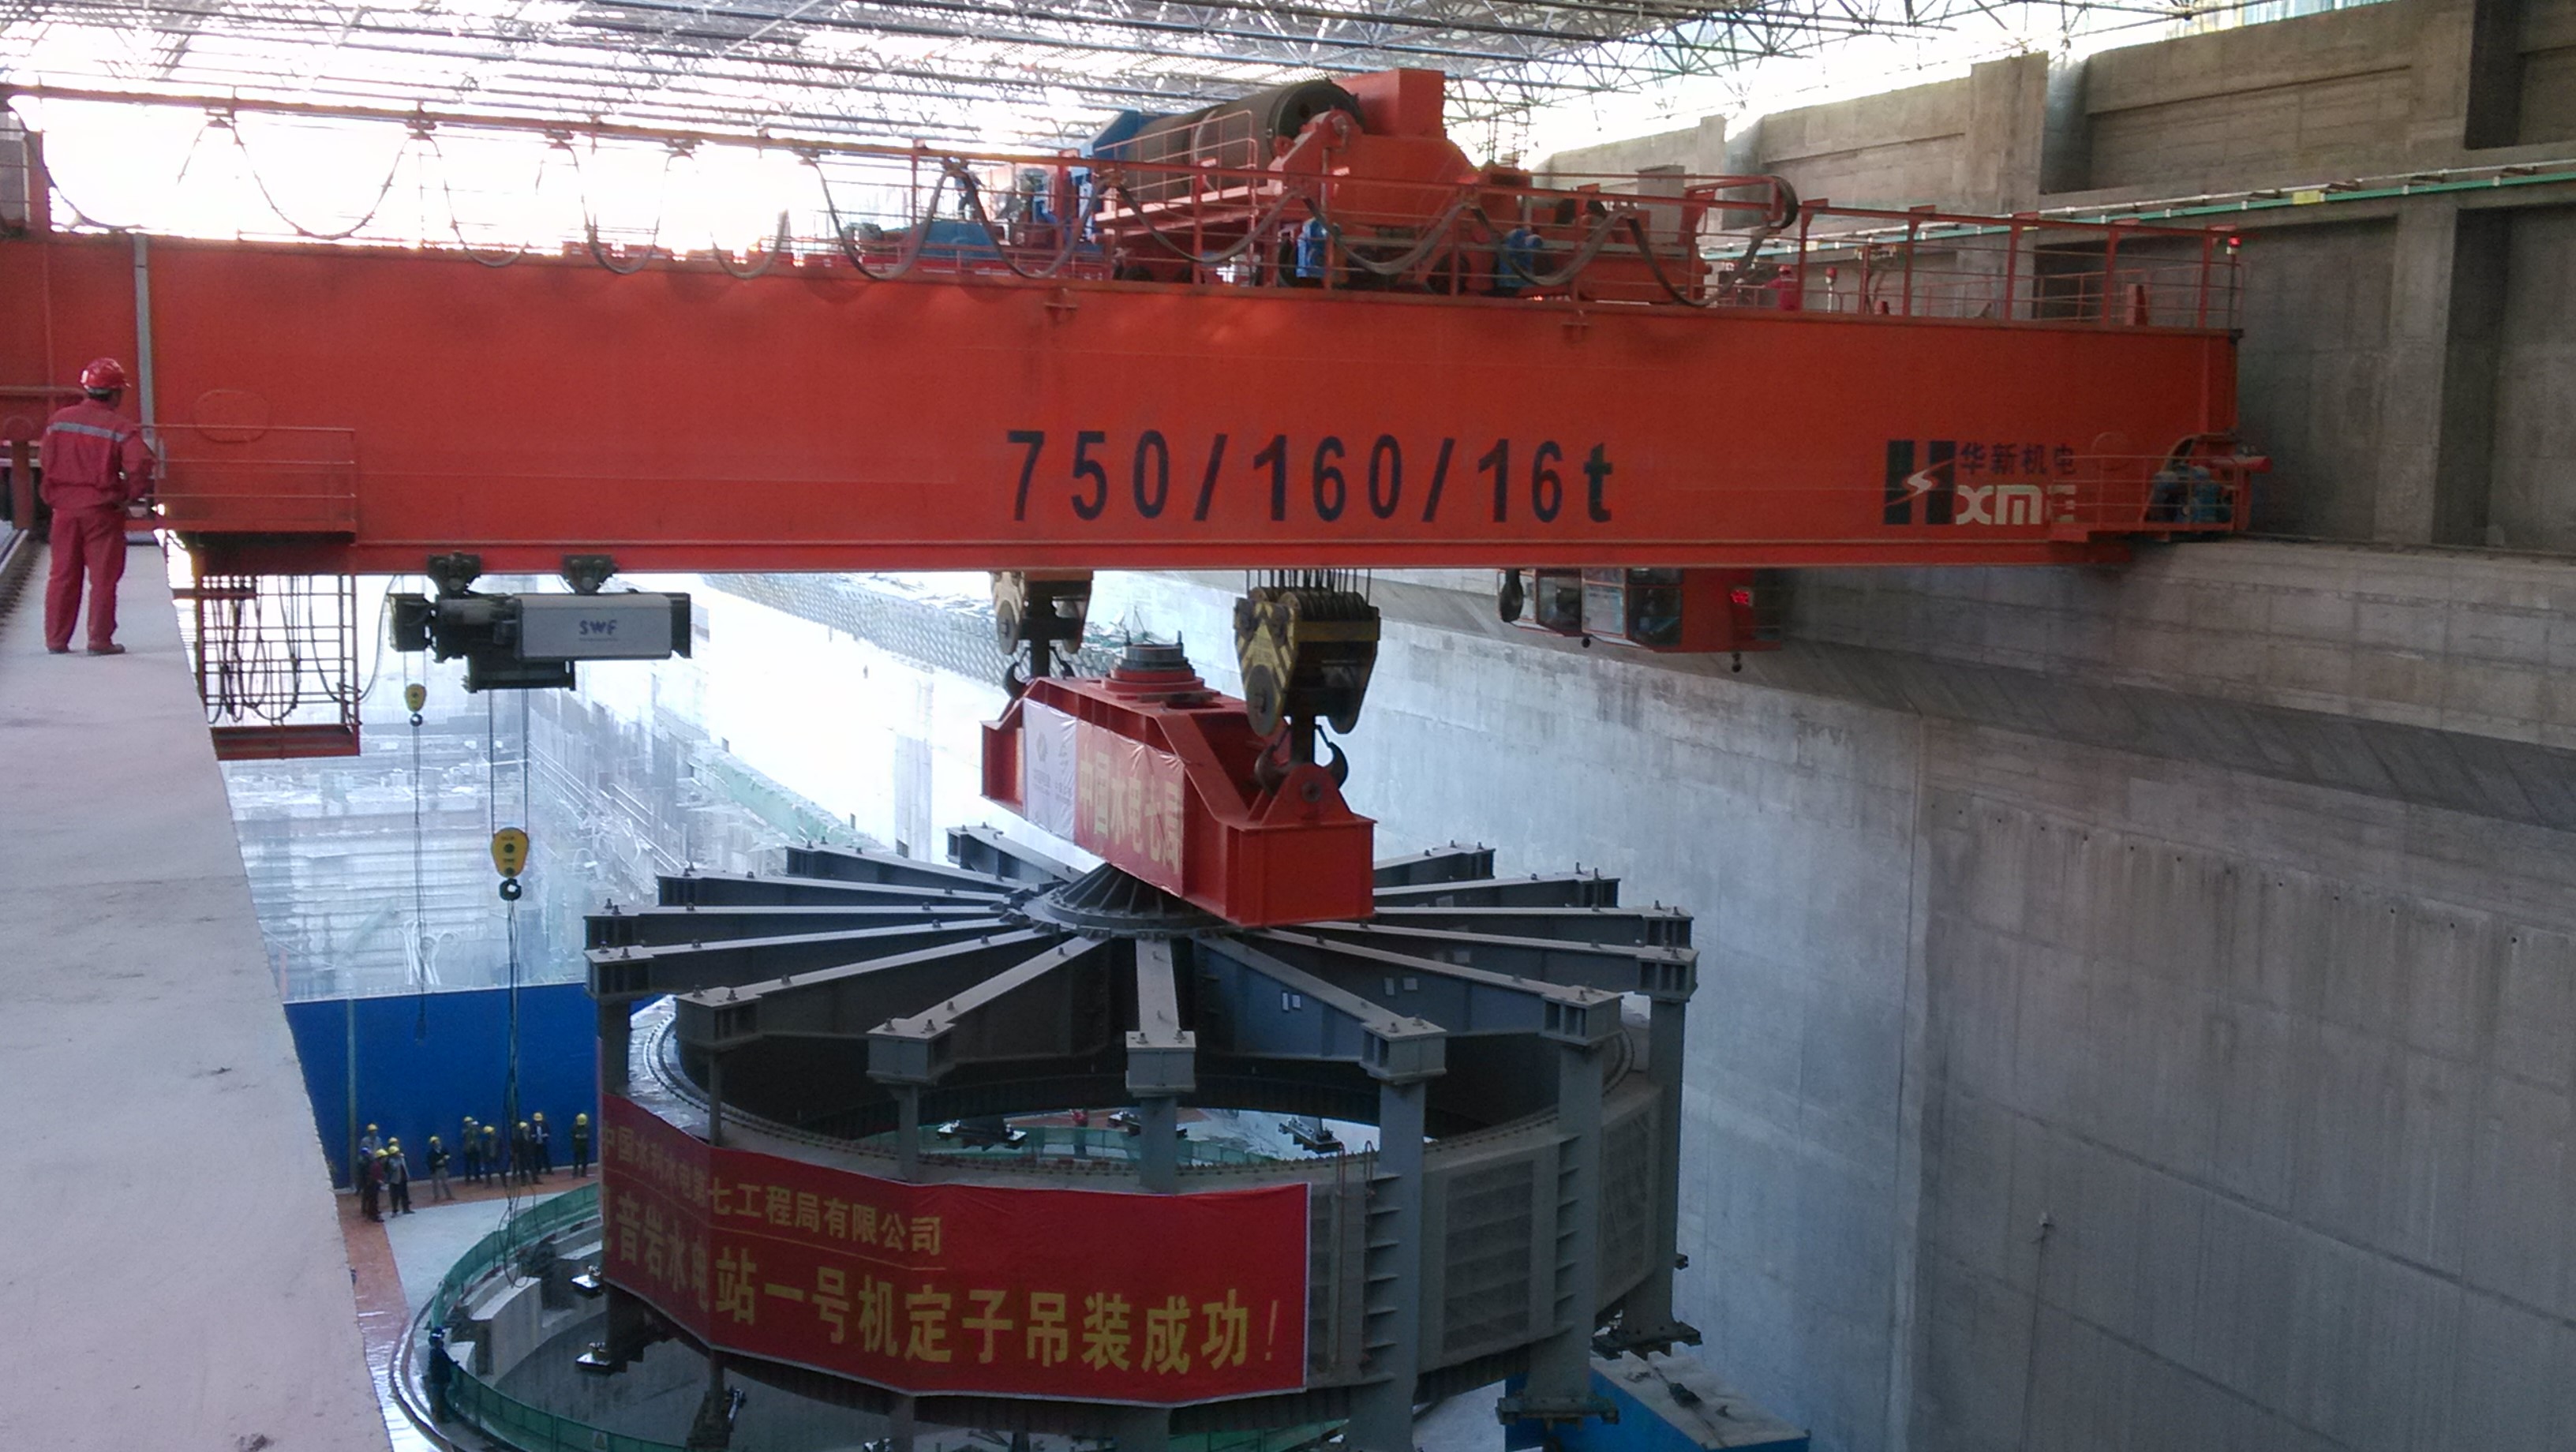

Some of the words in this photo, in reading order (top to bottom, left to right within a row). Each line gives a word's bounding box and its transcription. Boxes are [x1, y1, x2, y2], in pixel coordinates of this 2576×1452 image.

[1007, 430, 1614, 522] 750/160/16t
[1960, 442, 2076, 475] 华新机电
[579, 619, 617, 636] SWF
[1079, 740, 1181, 874] 中国水电七局
[602, 1185, 1279, 1375] 音岩水电站一号机定子吊装成功！
